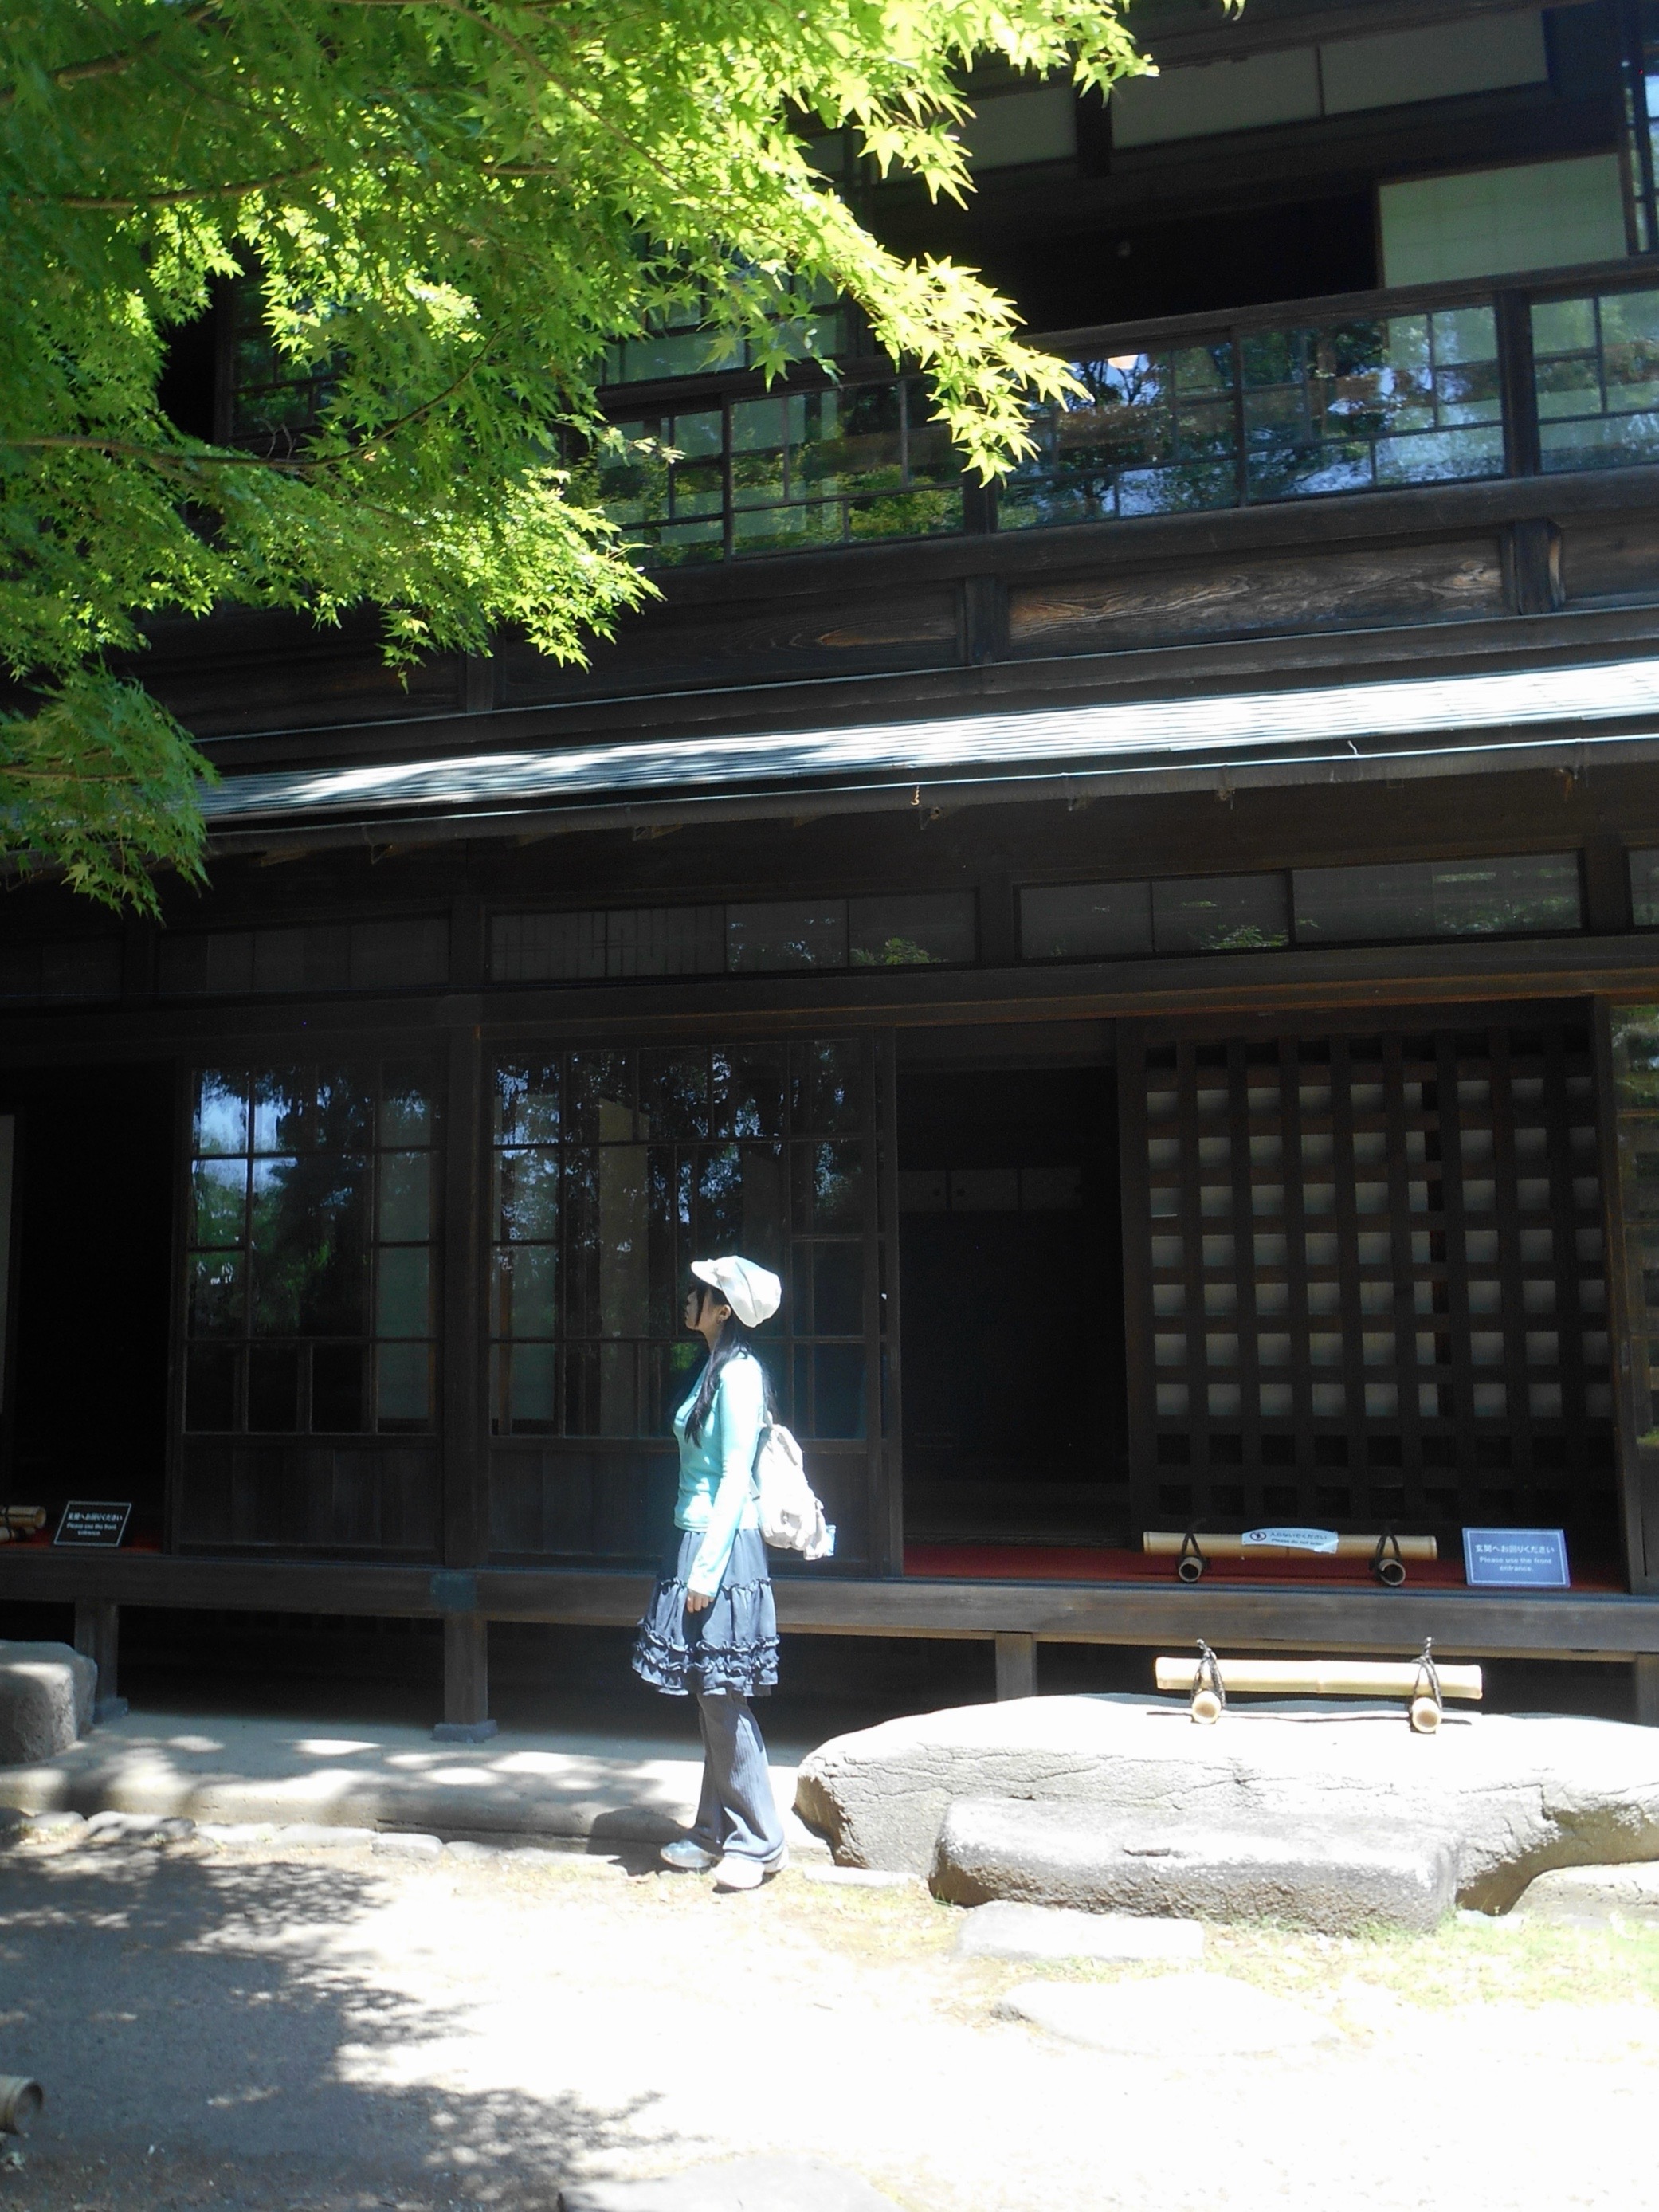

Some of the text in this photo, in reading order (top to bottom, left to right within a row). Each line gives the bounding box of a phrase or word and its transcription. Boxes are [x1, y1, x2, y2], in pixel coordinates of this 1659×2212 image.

[1475, 1544, 1555, 1554] 玄関へお回りください
